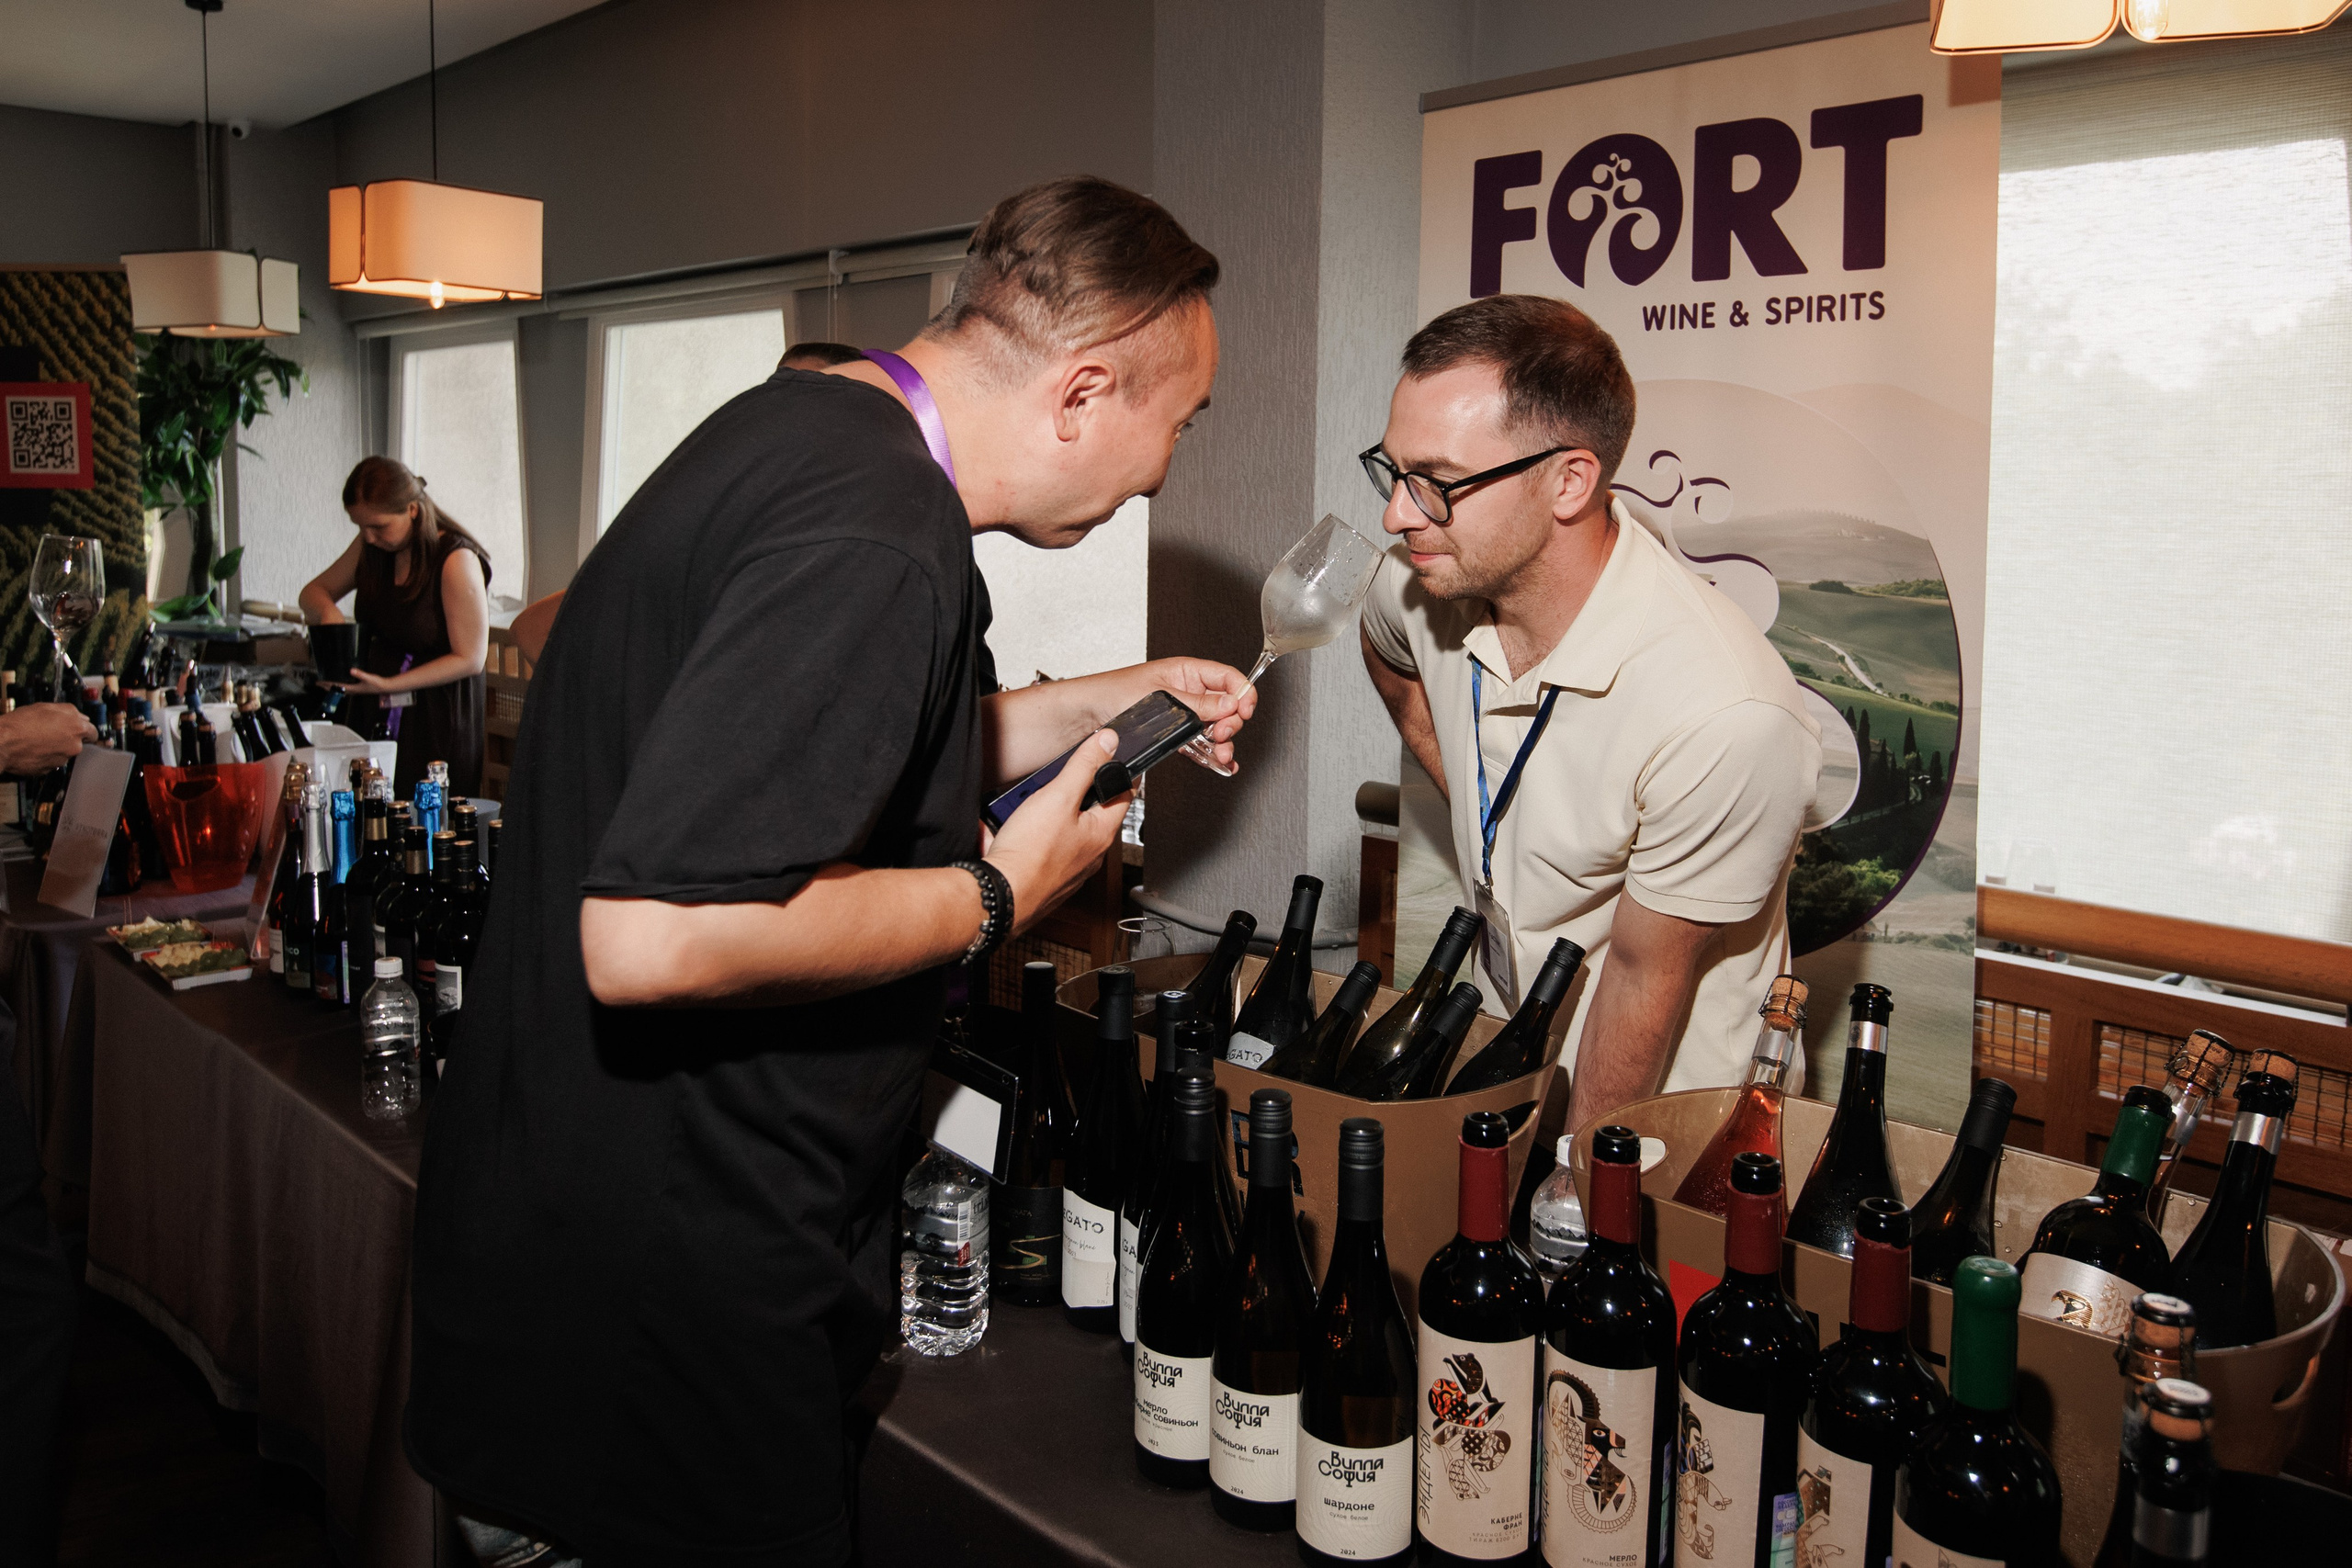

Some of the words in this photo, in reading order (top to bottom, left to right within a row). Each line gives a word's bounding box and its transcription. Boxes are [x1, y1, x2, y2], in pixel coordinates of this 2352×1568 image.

[1470, 94, 1924, 299] FORT
[1642, 301, 1716, 332] WINE
[1729, 300, 1750, 327] &
[1765, 291, 1886, 325] SPIRITS
[1143, 1350, 1182, 1378] Вилла
[1137, 1358, 1175, 1388] София
[1143, 1398, 1168, 1416] мерло
[1224, 1391, 1270, 1417] Вилла
[1153, 1413, 1199, 1427] совиньон
[1216, 1398, 1262, 1429] София
[1252, 1445, 1279, 1456] блан
[1330, 1450, 1385, 1471] Вилла
[1317, 1460, 1376, 1488] София
[1418, 1424, 1433, 1525] ЭНДЕМЫ
[1230, 1485, 1244, 1495] 2024
[1323, 1496, 1375, 1512] шардоне
[1329, 1511, 1348, 1520] сухое
[1490, 1512, 1522, 1525] КАБЕРНЕ
[1503, 1519, 1522, 1530] ФРАН
[1340, 1548, 1356, 1556] 2024
[1609, 1553, 1638, 1562] МЕРЛО
[1582, 1557, 1613, 1567] КРАСНОЕ
